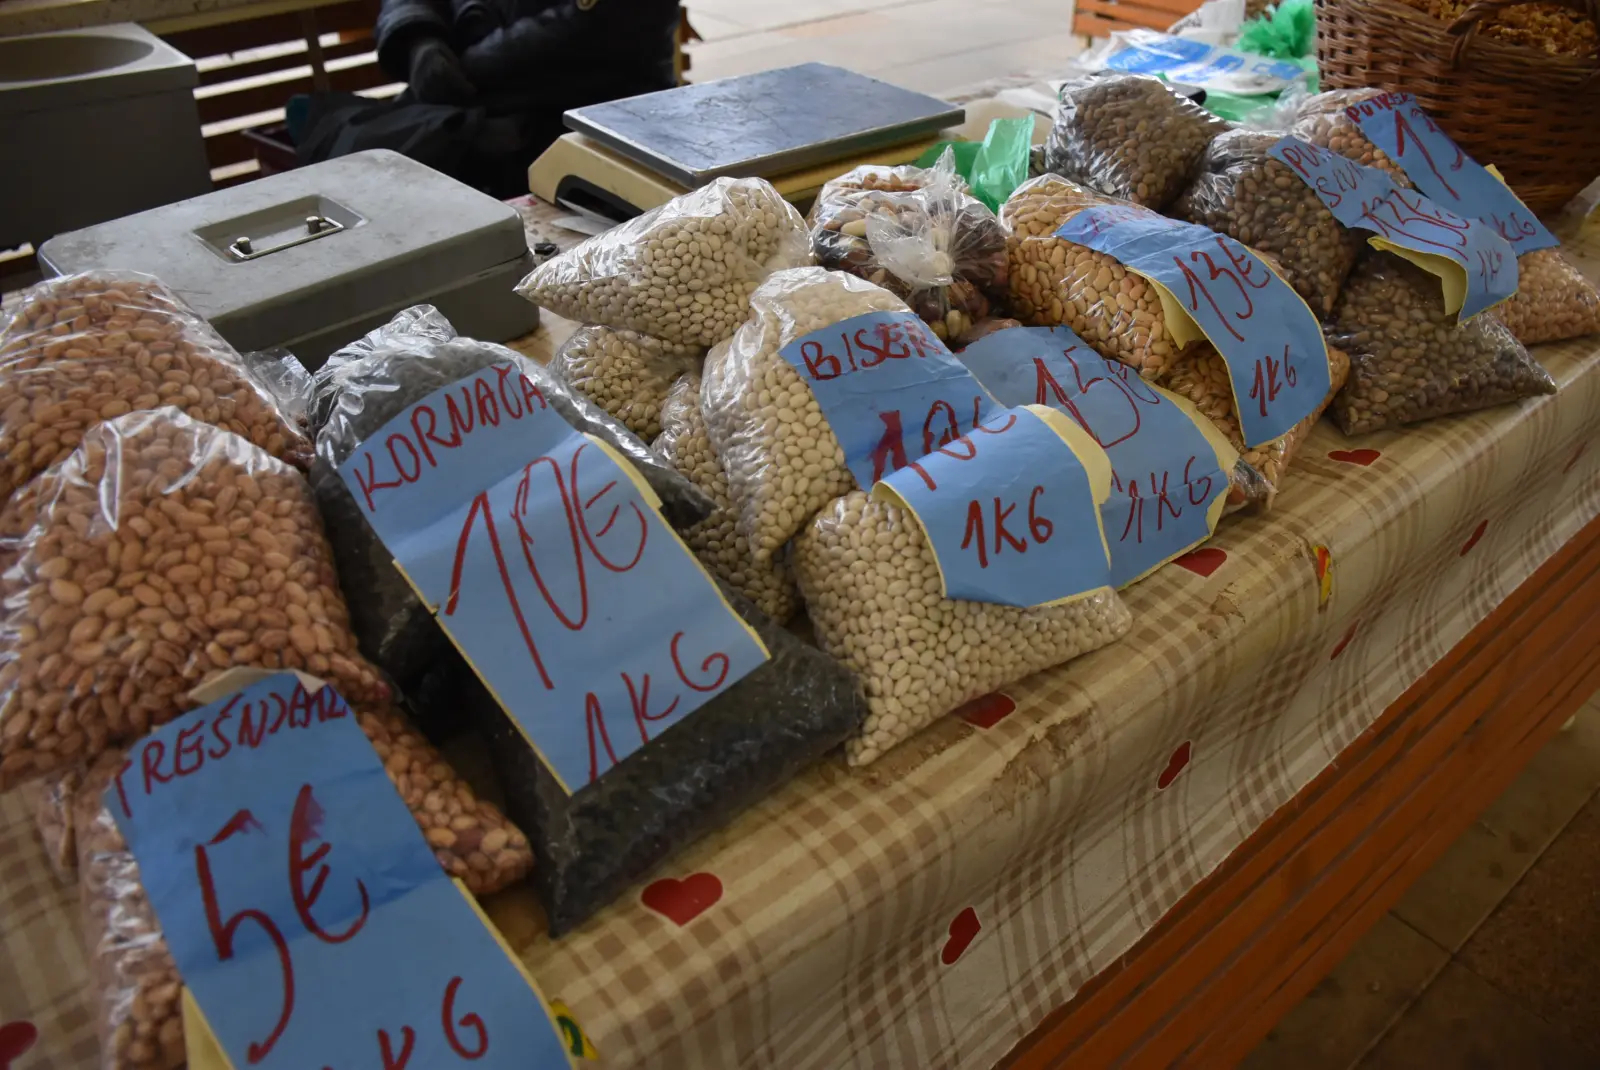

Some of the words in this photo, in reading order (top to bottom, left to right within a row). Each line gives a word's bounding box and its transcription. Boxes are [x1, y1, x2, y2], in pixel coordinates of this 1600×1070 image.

[444, 443, 648, 691] 10€
[960, 484, 1054, 568] 1KG
[585, 631, 730, 784] 1KG
[195, 782, 370, 1065] 5€
